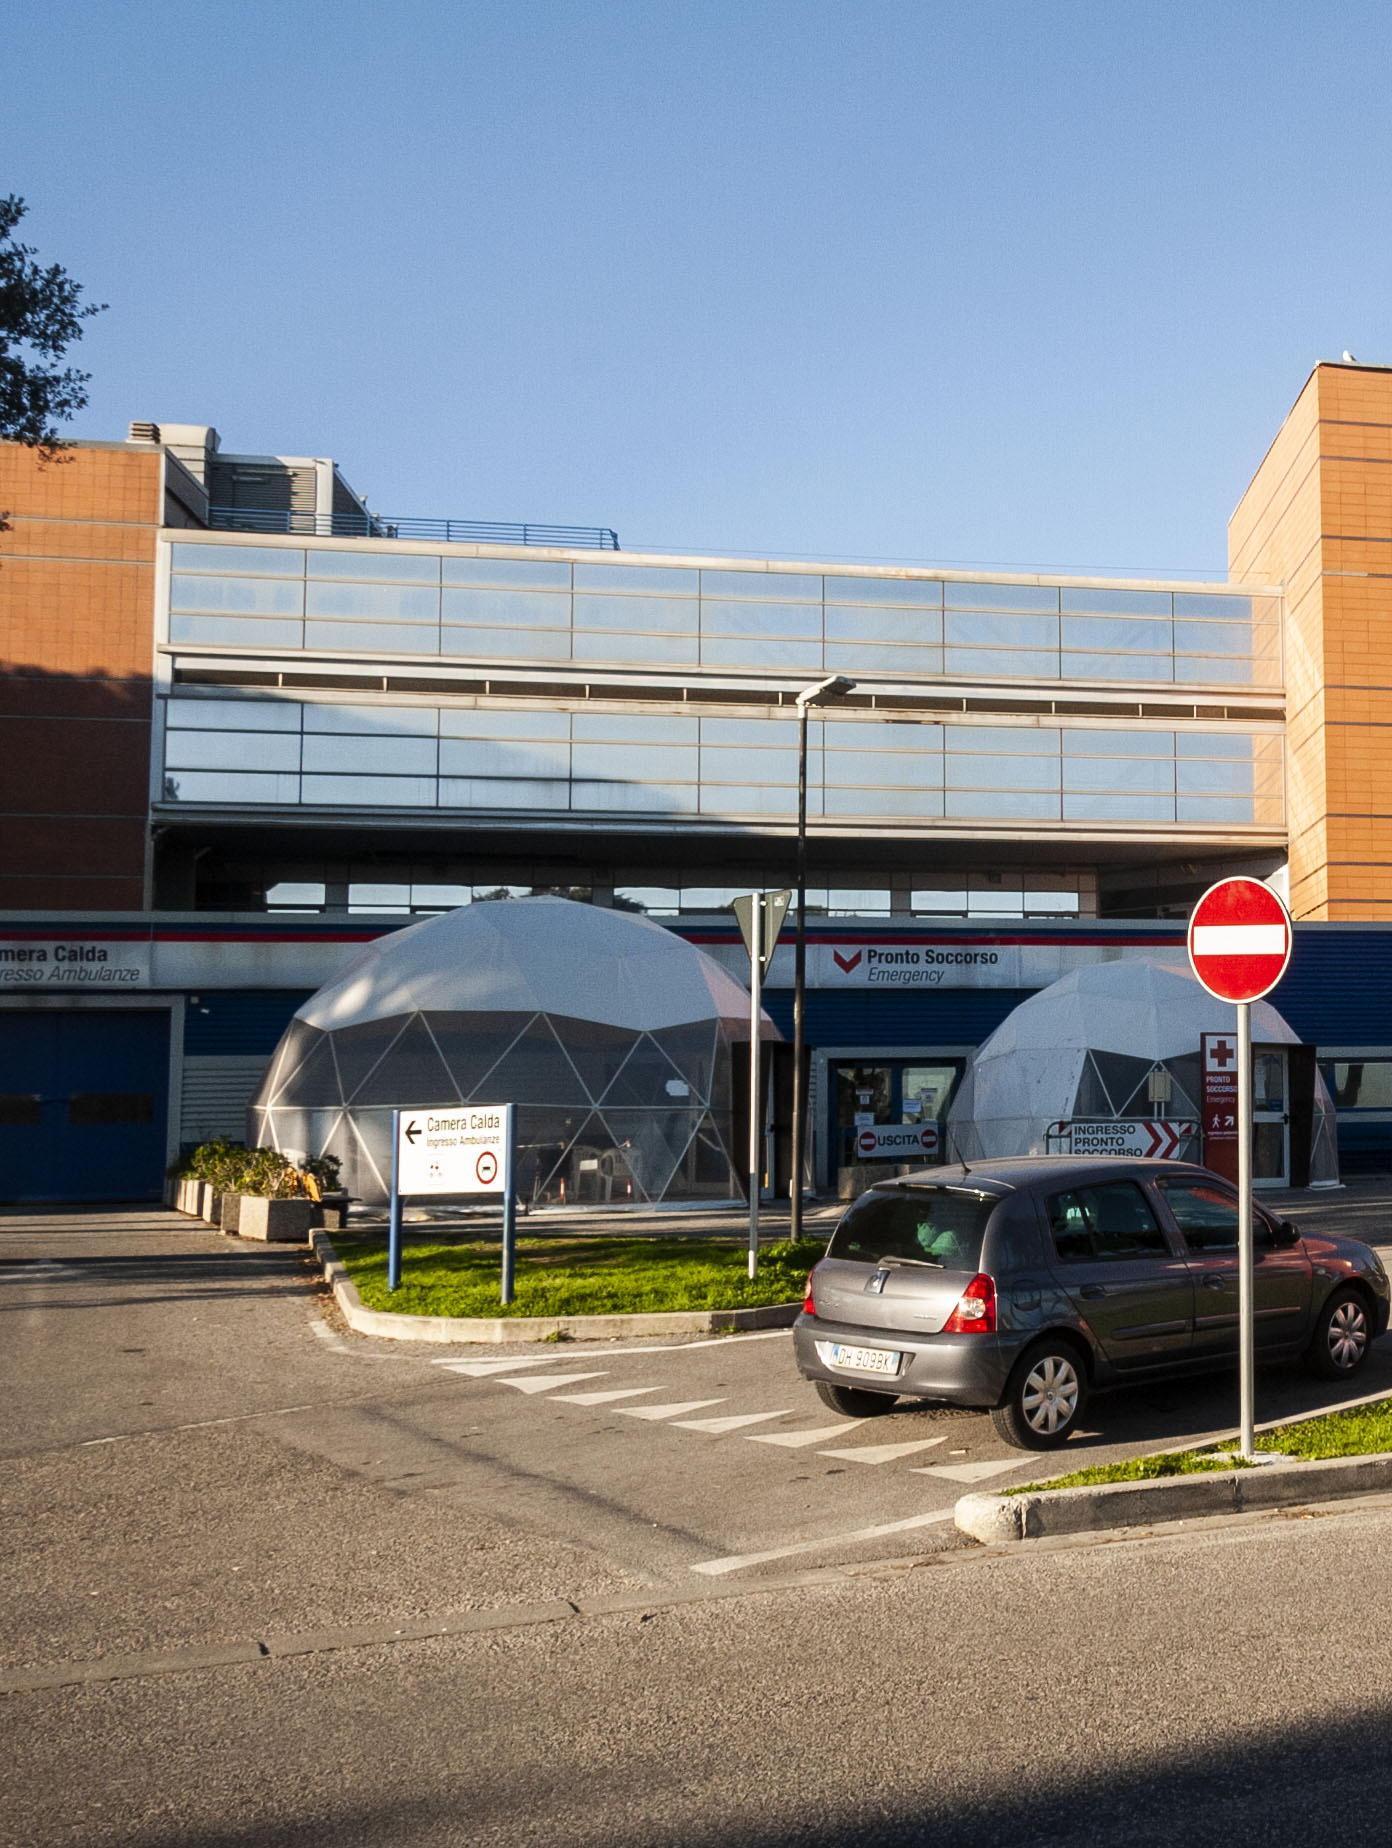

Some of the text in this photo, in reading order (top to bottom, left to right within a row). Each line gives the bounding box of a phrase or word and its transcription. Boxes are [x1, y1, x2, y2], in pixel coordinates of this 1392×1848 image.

[54, 945, 109, 962] Calda
[867, 949, 999, 965] Pronto Soccorso
[48, 965, 141, 982] Ambulanze
[867, 966, 945, 985] Emergency
[1206, 1075, 1231, 1084] PRONTO
[427, 1114, 500, 1132] Camera Calda
[1074, 1125, 1136, 1135] INGRESSO
[426, 1135, 500, 1149] Ingresso Ambulanze
[877, 1134, 920, 1147] USCITA
[1074, 1136, 1125, 1147] PRONTO
